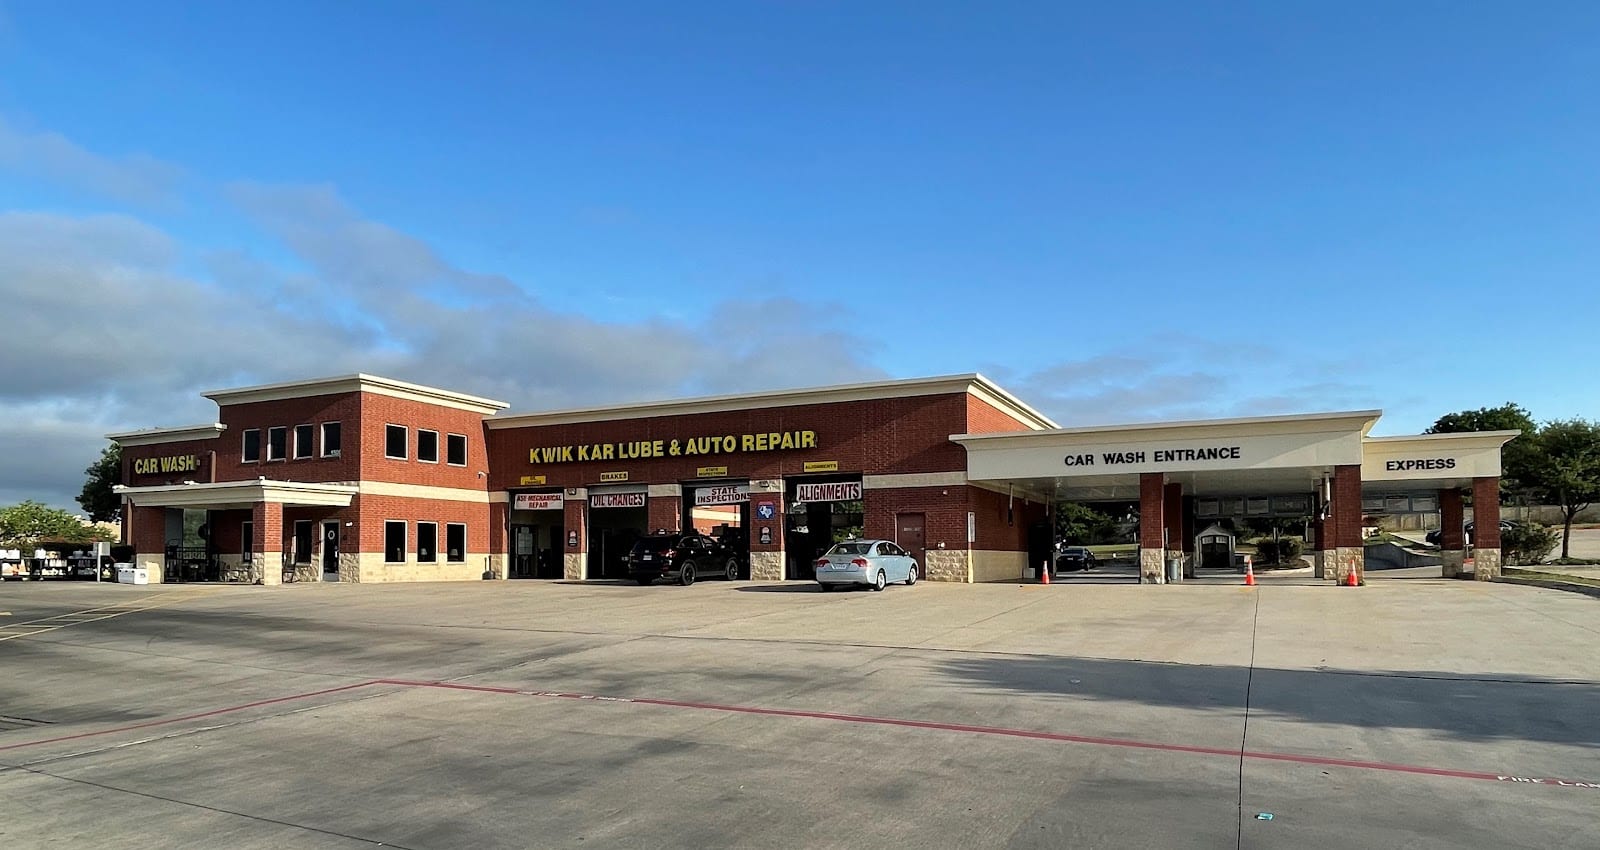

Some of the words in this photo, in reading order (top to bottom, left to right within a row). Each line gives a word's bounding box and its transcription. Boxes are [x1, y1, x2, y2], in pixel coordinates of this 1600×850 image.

[529, 445, 573, 464] KWIK
[578, 443, 614, 461] KAR
[618, 440, 664, 459] LUBE
[669, 438, 681, 457] &
[686, 435, 737, 455] AUTO
[742, 430, 815, 451] REPAIR
[1064, 453, 1095, 467] CAR
[1103, 450, 1145, 465] WASH
[1154, 446, 1240, 462] ENTRANCE
[134, 457, 159, 475] CAR
[160, 455, 196, 473] WASH
[1385, 458, 1456, 472] EXPRESS
[601, 472, 627, 480] BRAKES
[711, 486, 737, 495] STATE
[798, 482, 860, 501] ALIGNMENTS
[593, 494, 606, 506] OIL
[607, 493, 643, 506] CHANGES
[697, 493, 751, 503] INSPECTIONS
[528, 501, 549, 509] REPAIR
